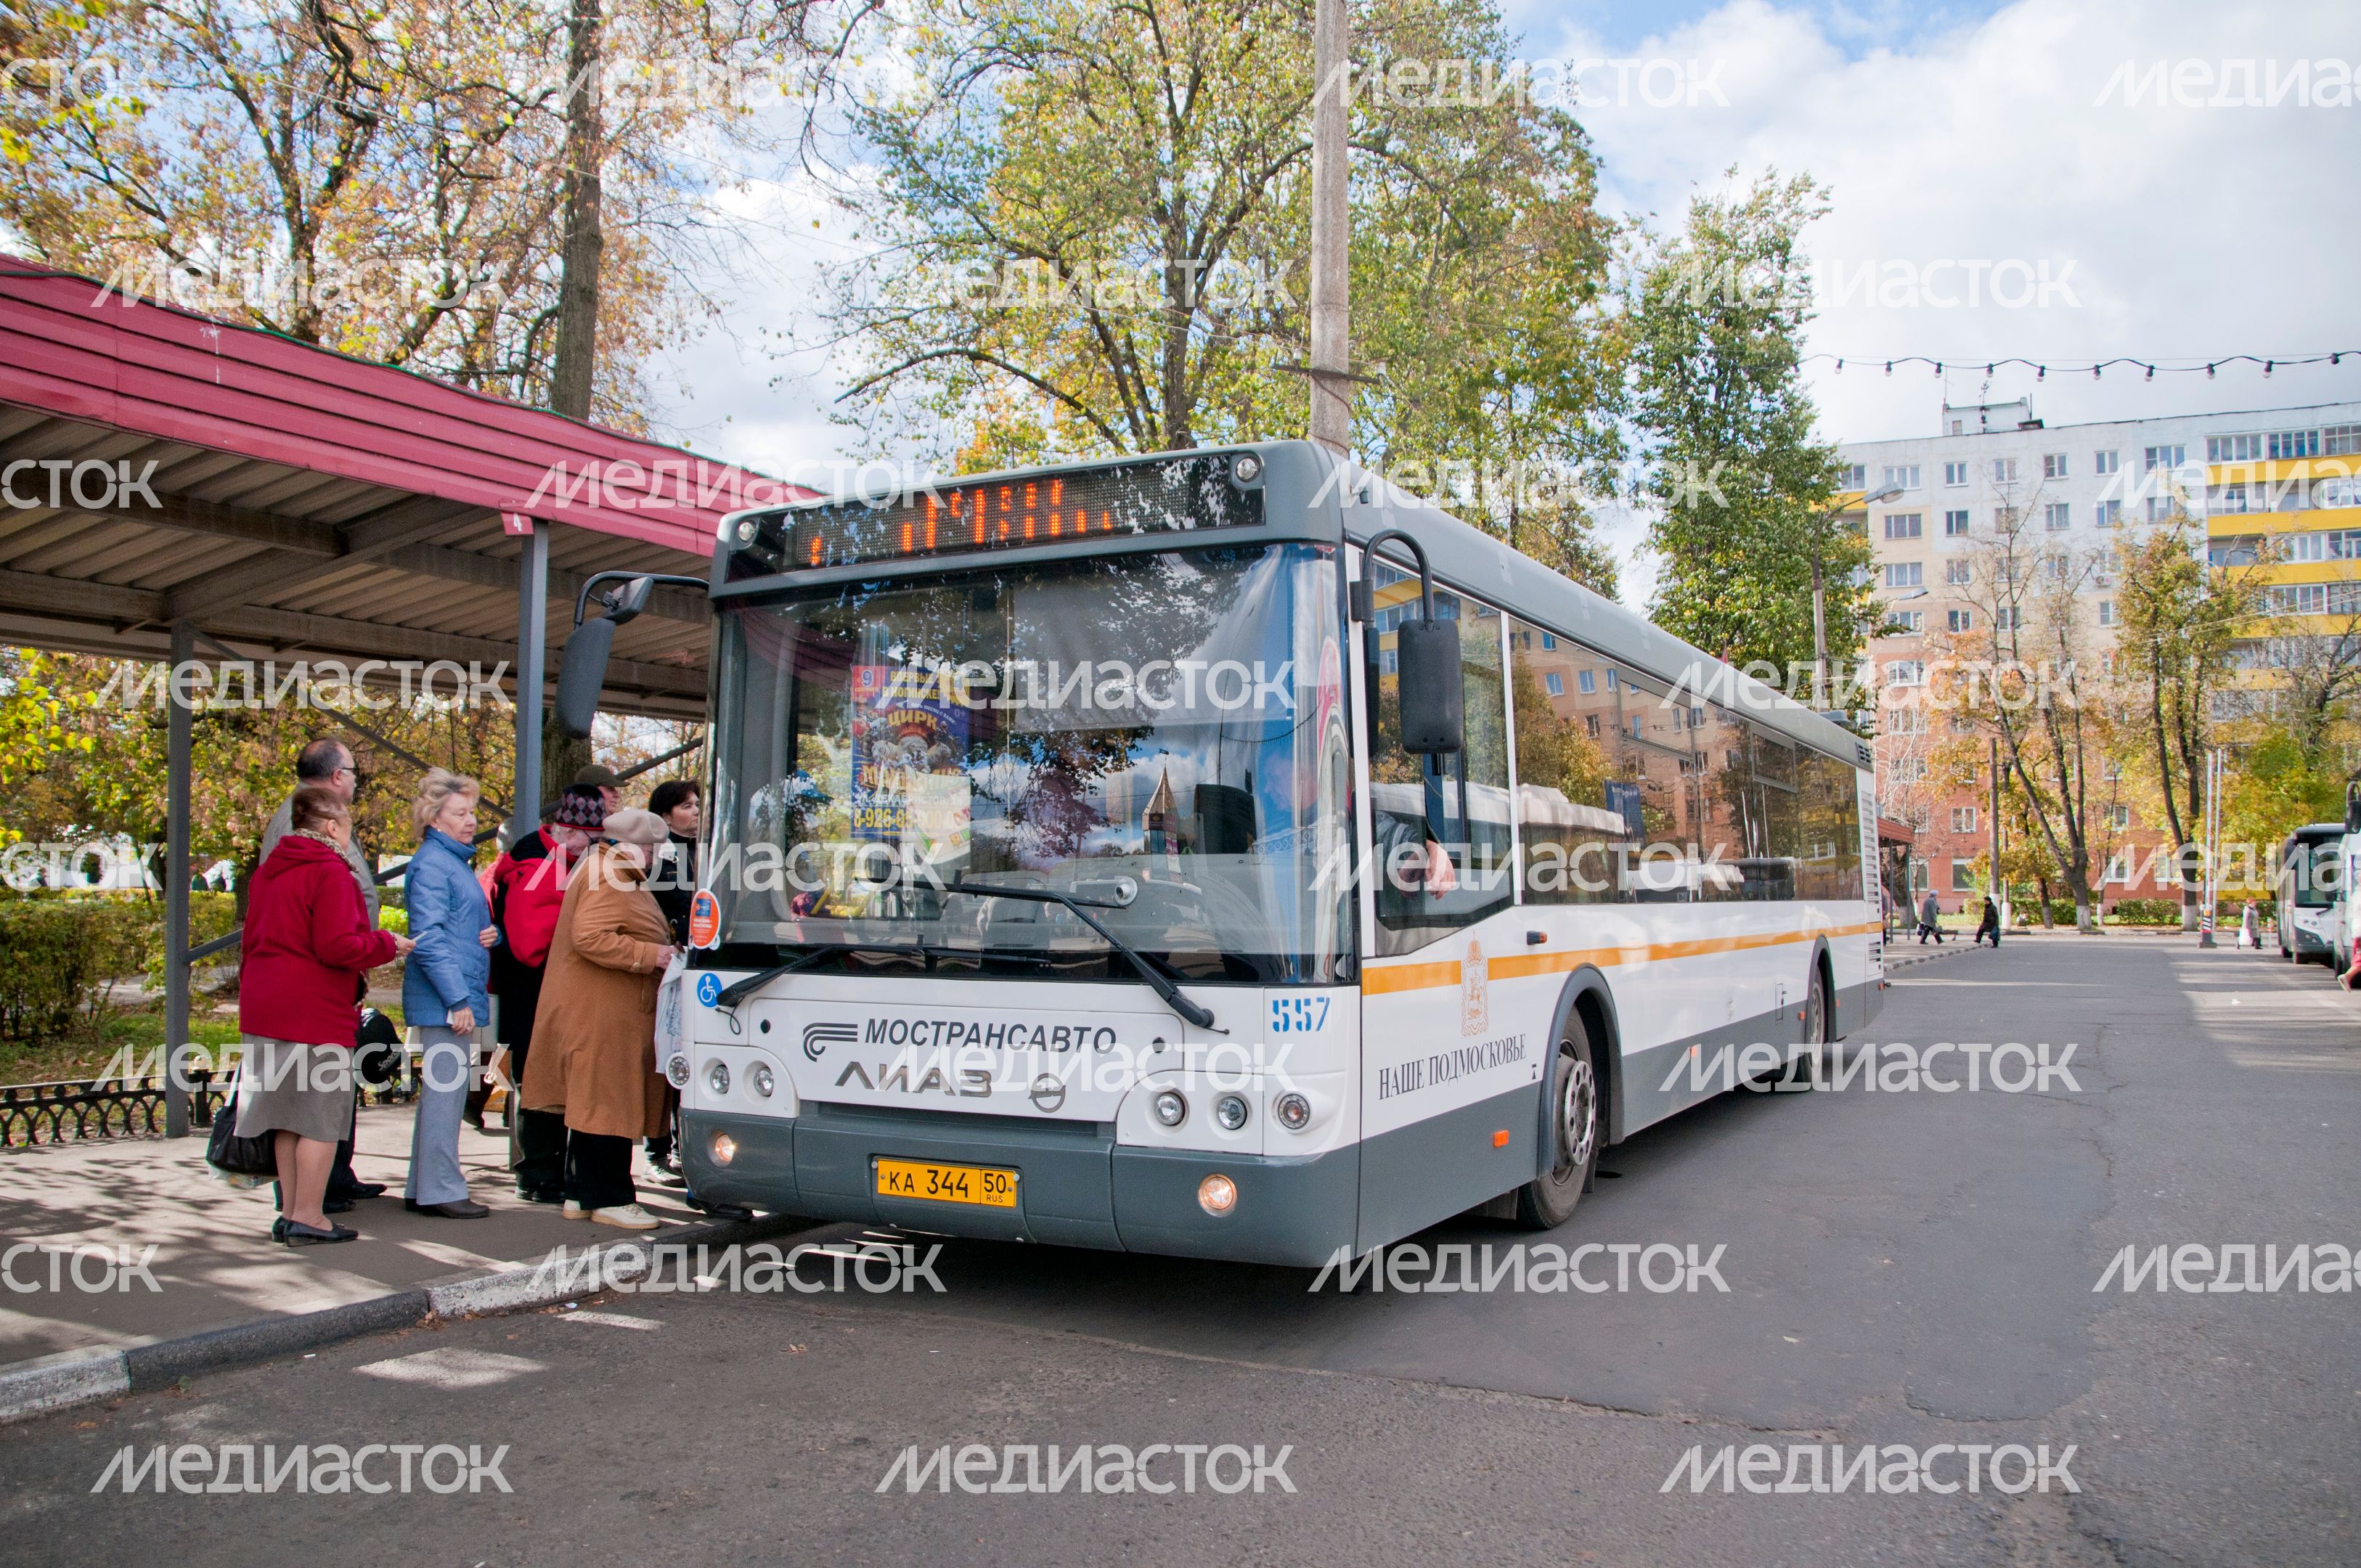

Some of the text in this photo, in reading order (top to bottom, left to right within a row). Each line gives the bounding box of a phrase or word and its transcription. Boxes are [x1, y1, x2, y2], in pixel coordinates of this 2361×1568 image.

[861, 669, 873, 687] 9
[890, 671, 934, 685] ВПЕРВЫЕ
[887, 709, 938, 731] ЦИРК
[1272, 997, 1330, 1032] 557
[865, 1018, 1117, 1055] МОСТРАНСАВТО
[835, 1061, 992, 1098] ЛИАЗ
[1379, 1033, 1526, 1100] НАШЕ ПОДМОСКОВЬЕ
[889, 1169, 1006, 1199] КА 344 50
[986, 1194, 1003, 1203] RUS
